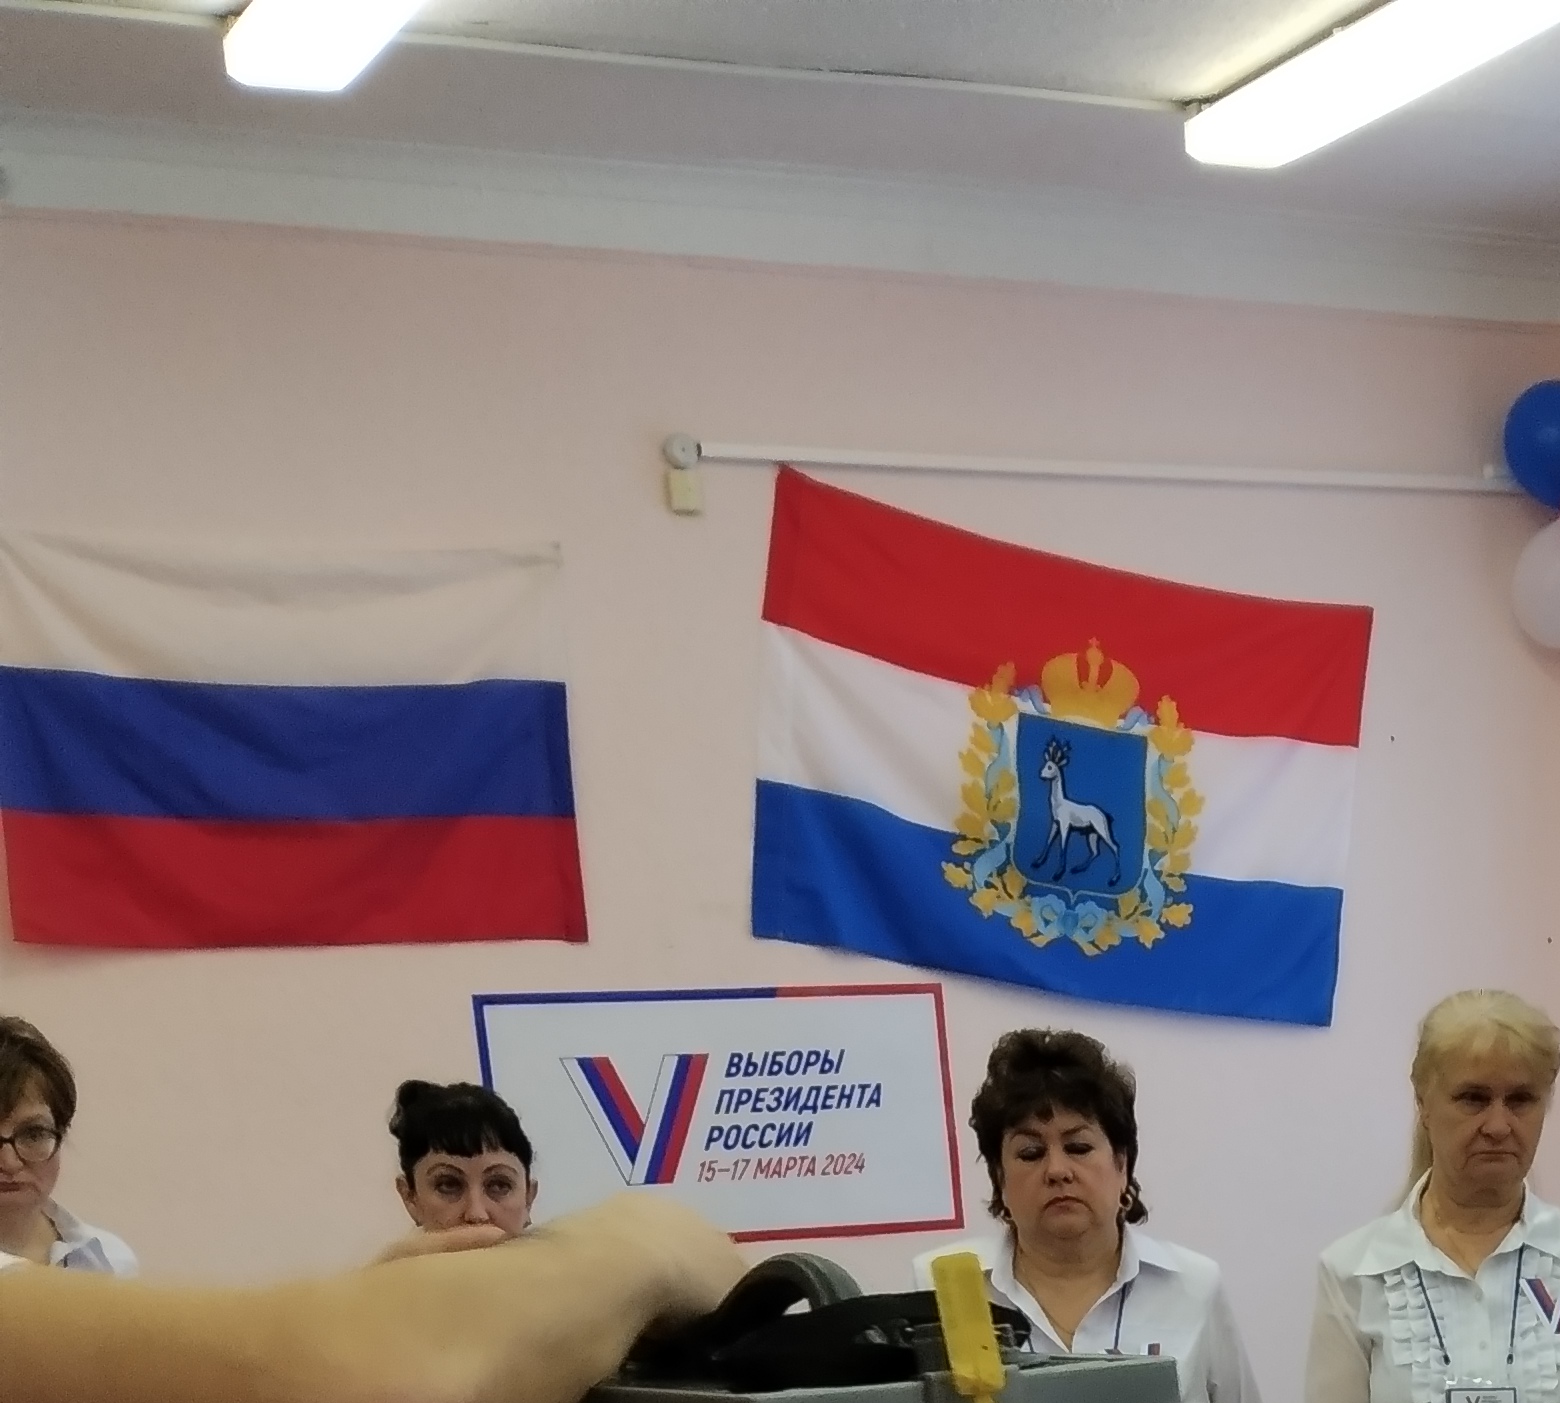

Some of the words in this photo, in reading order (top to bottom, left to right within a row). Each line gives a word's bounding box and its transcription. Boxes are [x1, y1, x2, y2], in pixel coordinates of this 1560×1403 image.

[724, 1049, 845, 1078] ВЫБОРЫ
[714, 1083, 882, 1115] ПРЕЗИДЕНТА
[704, 1121, 813, 1151] РОССИИ
[697, 1158, 751, 1183] 15–17
[753, 1156, 816, 1180] МАРТА
[821, 1152, 866, 1177] 2024
